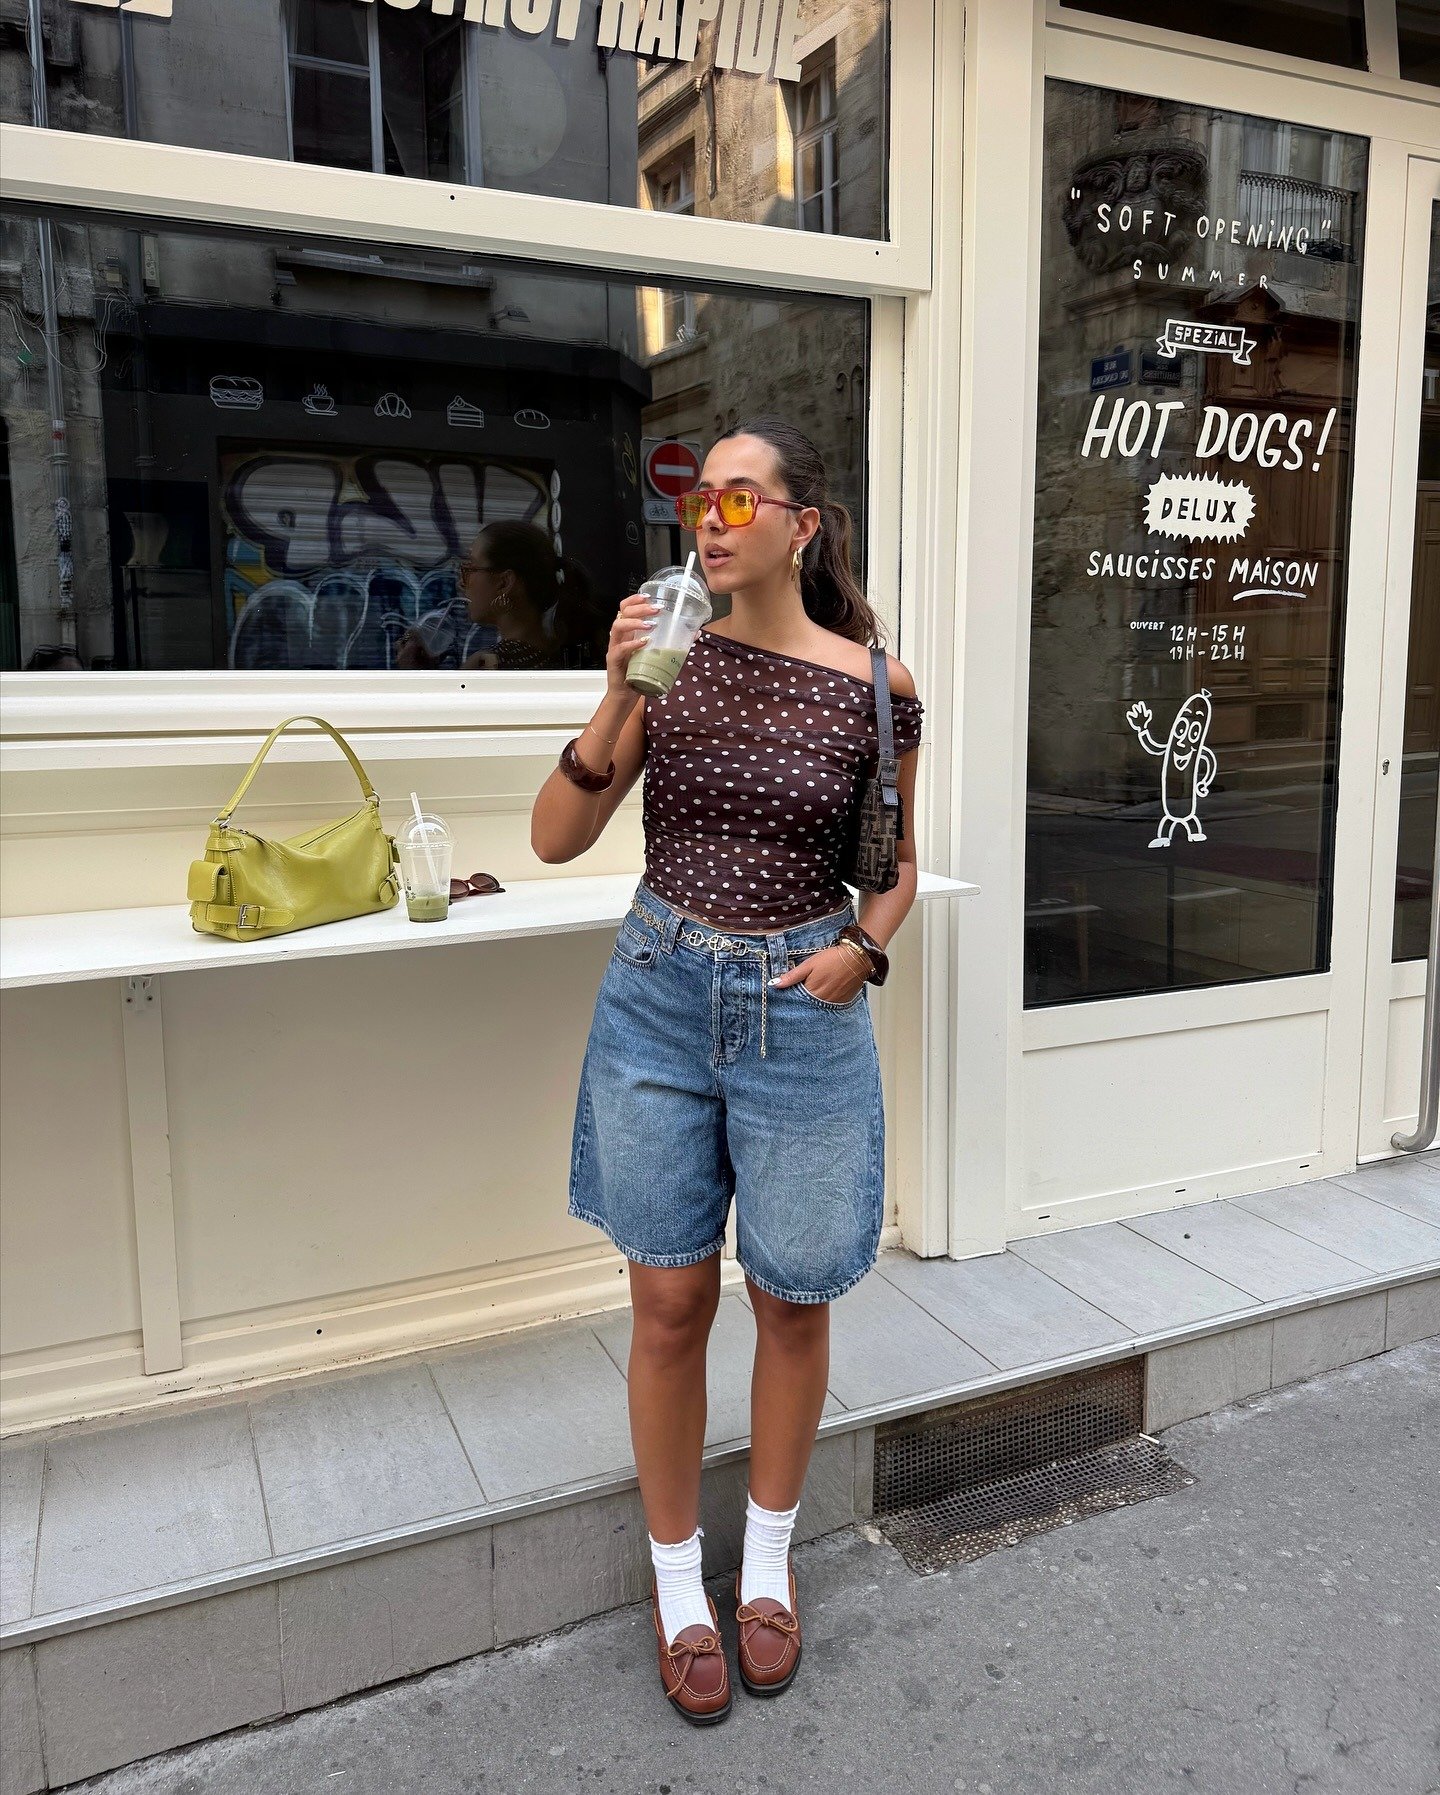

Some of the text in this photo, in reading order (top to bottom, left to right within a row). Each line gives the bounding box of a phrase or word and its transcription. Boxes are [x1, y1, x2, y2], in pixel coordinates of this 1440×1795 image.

[1132, 259, 1269, 290] SUMMER
[1080, 394, 1338, 473] HOT DOGS!
[1160, 496, 1237, 524] DELUX
[1129, 621, 1166, 632] OUVERT
